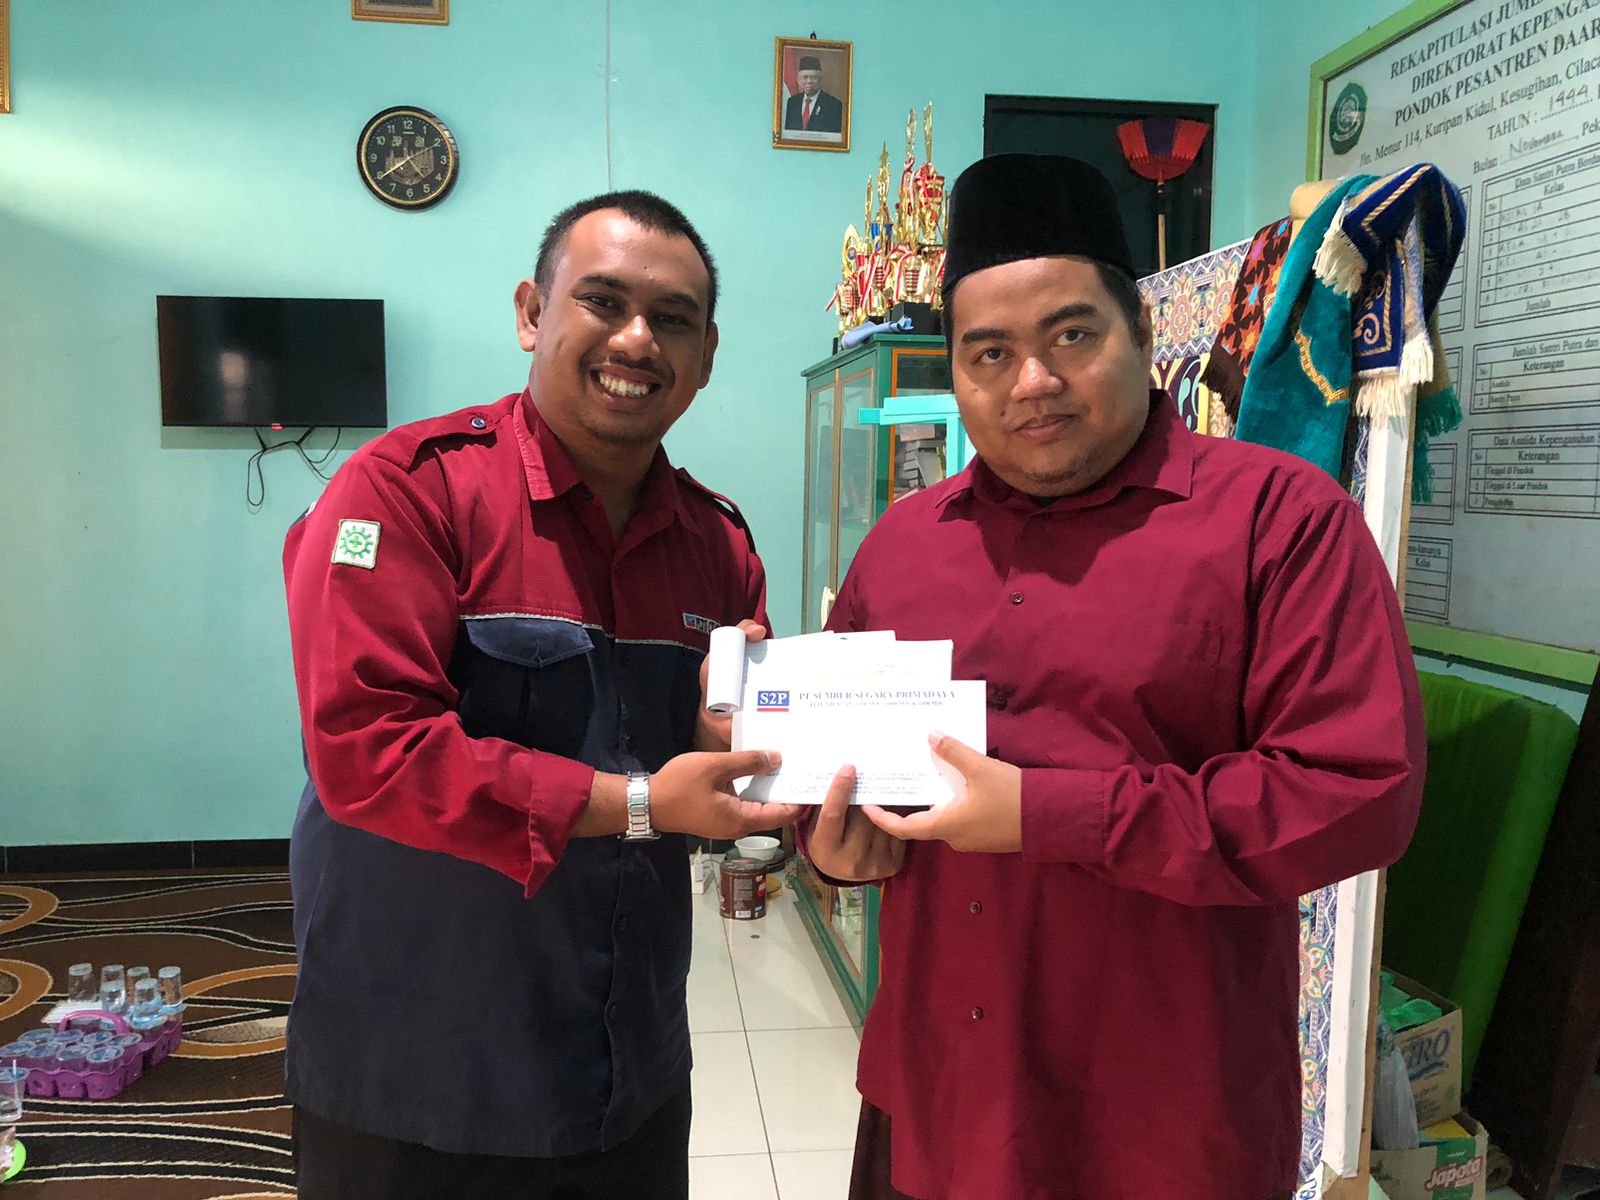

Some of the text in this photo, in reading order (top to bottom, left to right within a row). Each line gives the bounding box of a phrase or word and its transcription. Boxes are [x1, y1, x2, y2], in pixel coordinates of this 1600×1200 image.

[1390, 10, 1494, 79] REKAPITULASI
[1411, 32, 1506, 93] DIREKTORAT
[1394, 85, 1452, 127] PONDOK
[1455, 40, 1548, 99] PESANTREN
[387, 124, 396, 134] 11
[403, 120, 413, 130] 12
[422, 125, 427, 135] 1
[1487, 111, 1531, 140] TAHUN
[376, 136, 386, 146] 10
[1374, 140, 1402, 161] Menur
[1425, 114, 1463, 139] Kuripan
[370, 153, 378, 163] 9
[440, 155, 447, 165] 3
[376, 170, 384, 180] 8
[435, 173, 442, 181] 4
[389, 183, 397, 192] 7
[423, 184, 430, 193] 5
[406, 188, 414, 198] 6
[1523, 360, 1565, 373] Keterangan
[1518, 450, 1560, 464] Keterangan
[759, 692, 788, 705] S2P
[896, 689, 956, 699] PRIMADAYA
